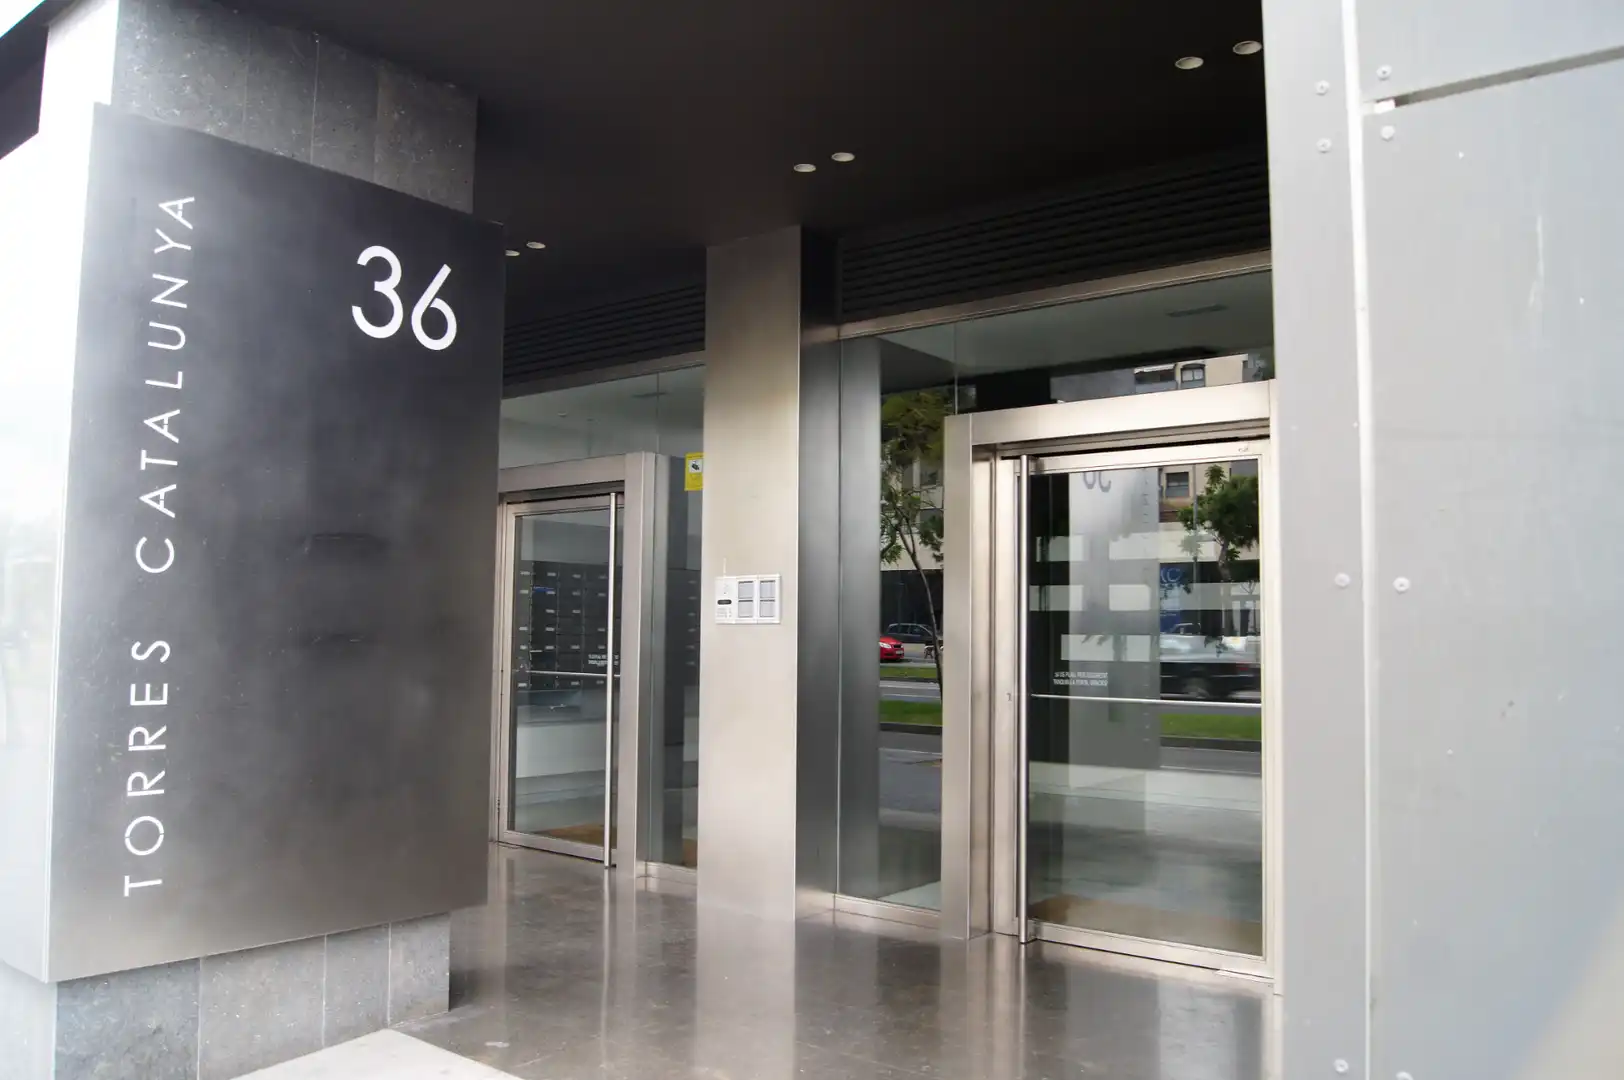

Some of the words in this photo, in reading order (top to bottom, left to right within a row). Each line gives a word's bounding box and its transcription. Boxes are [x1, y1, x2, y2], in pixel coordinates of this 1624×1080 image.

[135, 195, 196, 574] CATALUNYA
[351, 244, 458, 351] 36
[123, 639, 172, 898] TORRES
